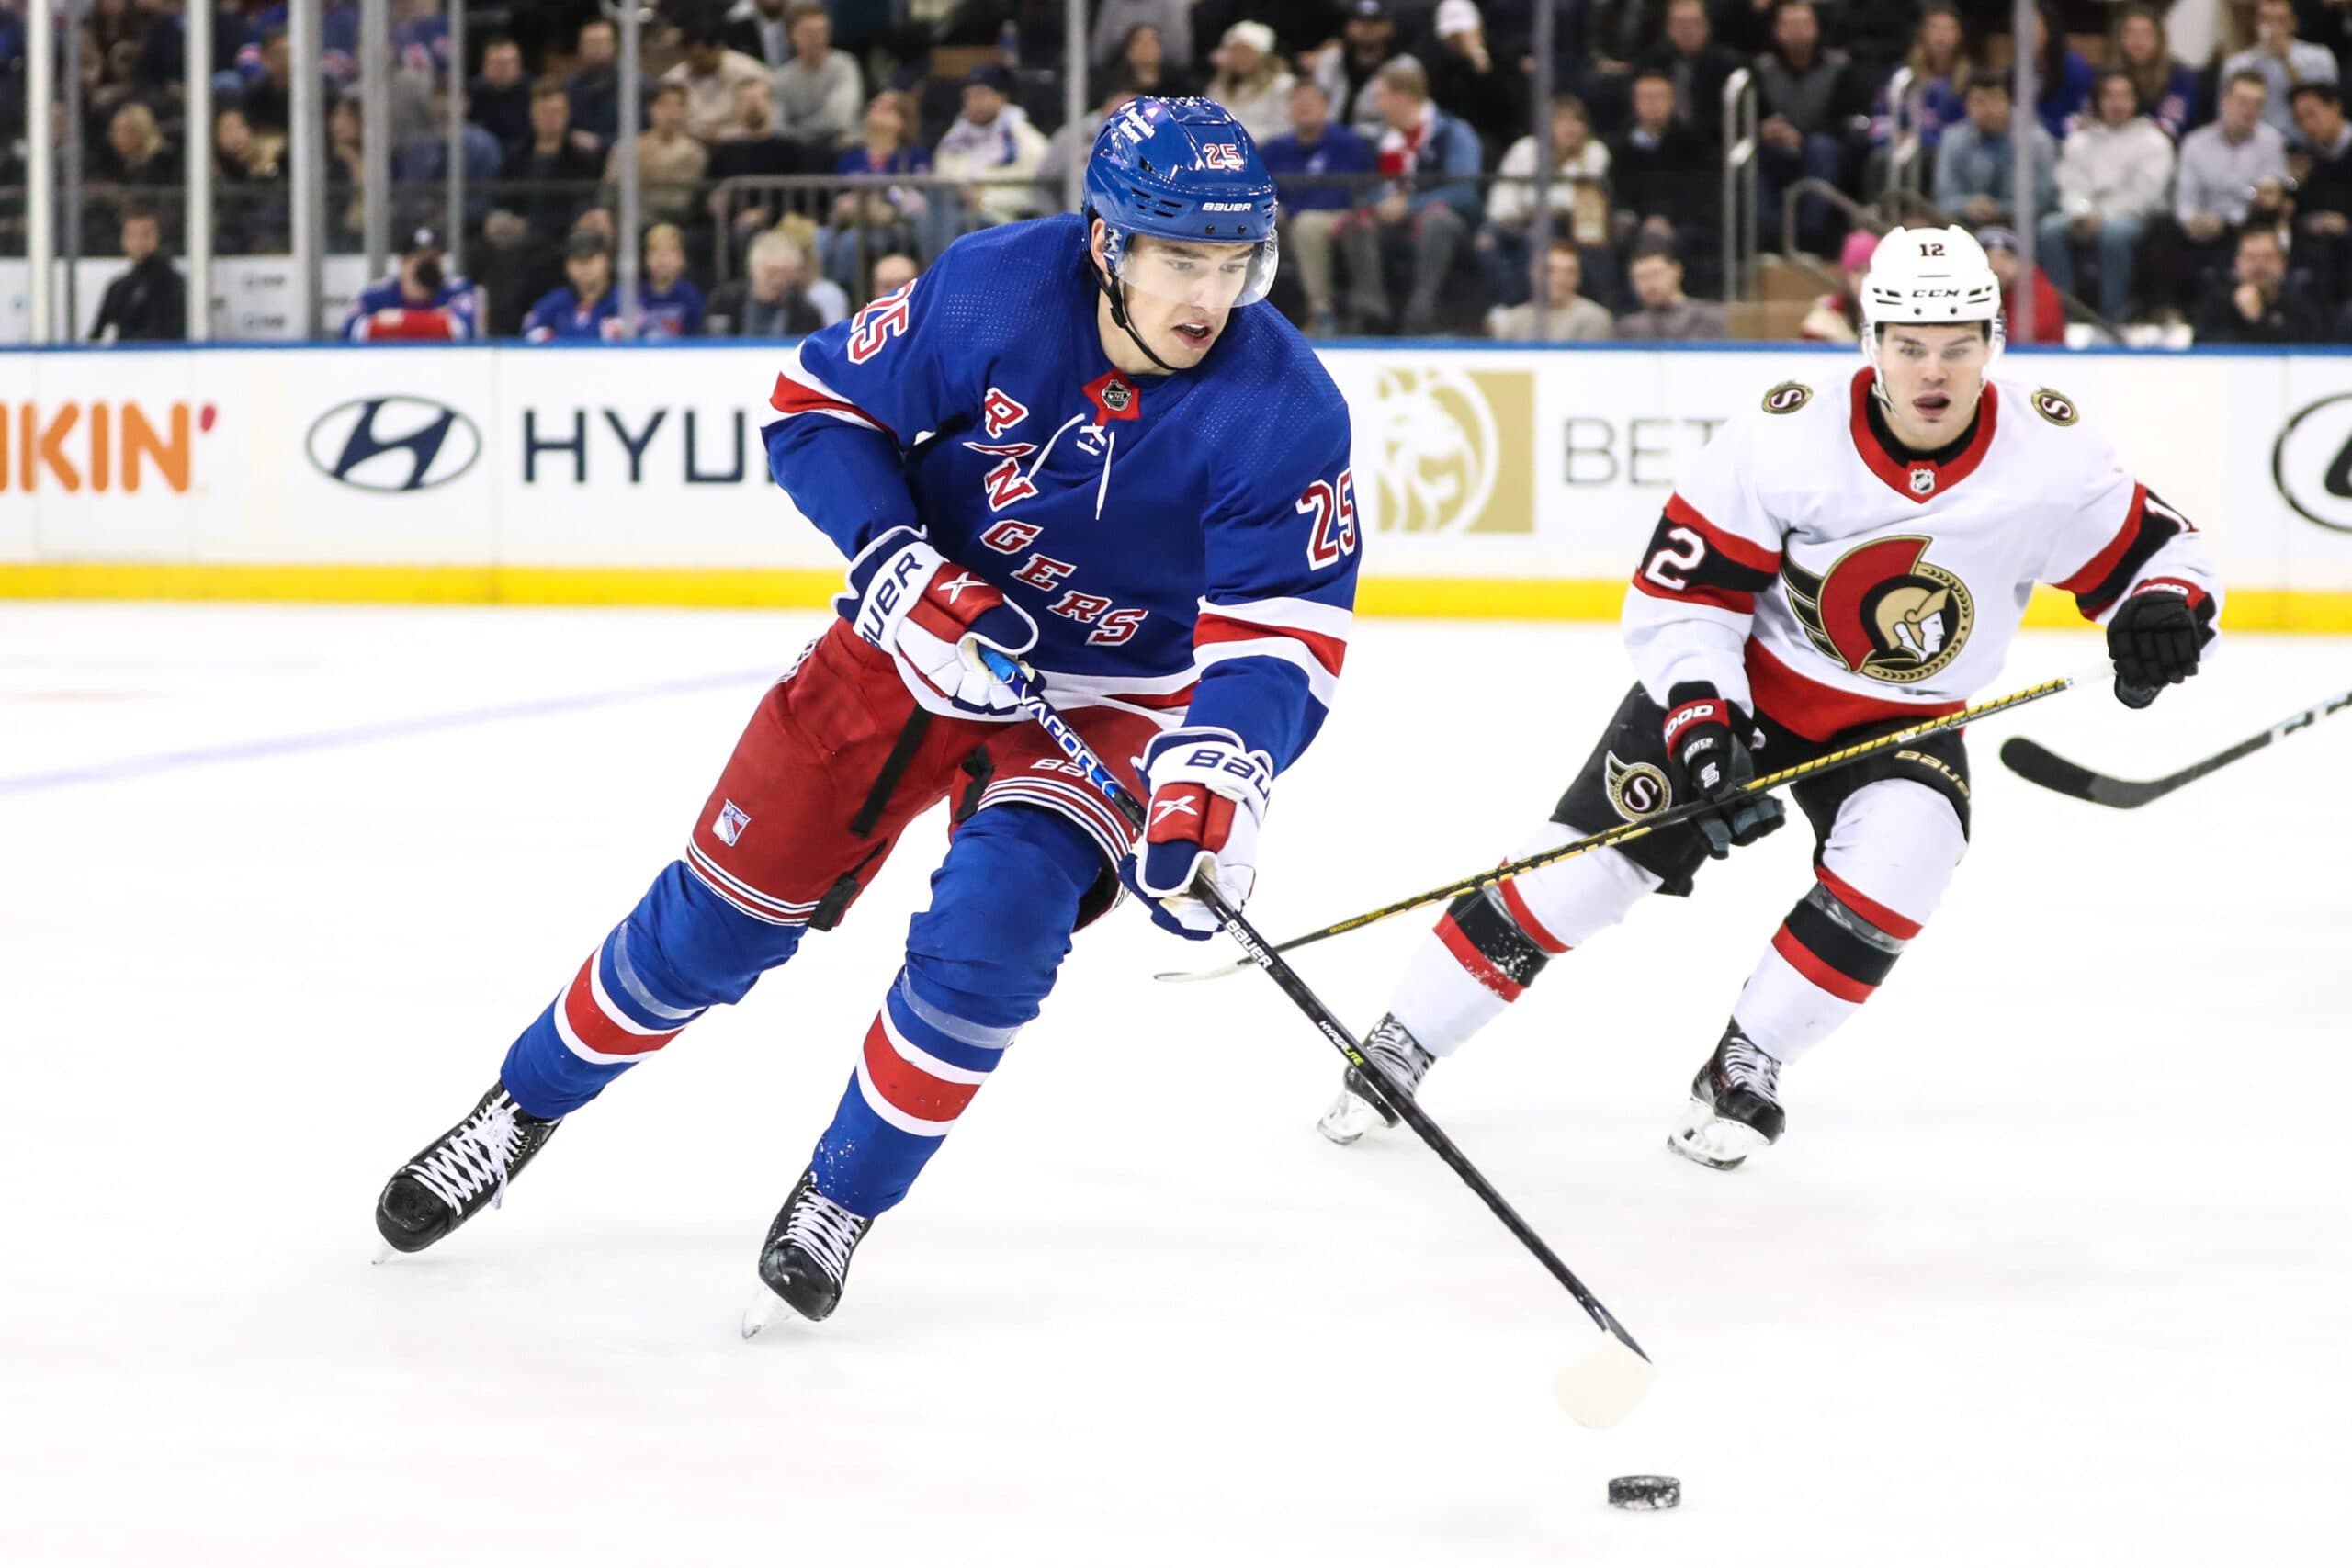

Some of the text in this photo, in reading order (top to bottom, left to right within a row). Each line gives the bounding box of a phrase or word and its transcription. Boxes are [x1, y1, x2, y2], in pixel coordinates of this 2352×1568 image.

[1203, 143, 1244, 171] 25
[1202, 201, 1253, 212] BAUER
[1918, 243, 1946, 257] 12
[1911, 289, 1961, 298] CCM
[847, 277, 918, 365] 25
[0, 402, 217, 493] KIN'
[524, 409, 777, 484] HYU
[962, 387, 1149, 646] RANGERS
[1295, 466, 1356, 572] 25
[1029, 758, 1091, 782] BA
[1184, 749, 1272, 808] BAU
[1894, 750, 1971, 797] BAUE
[1225, 919, 1274, 970] BAUER
